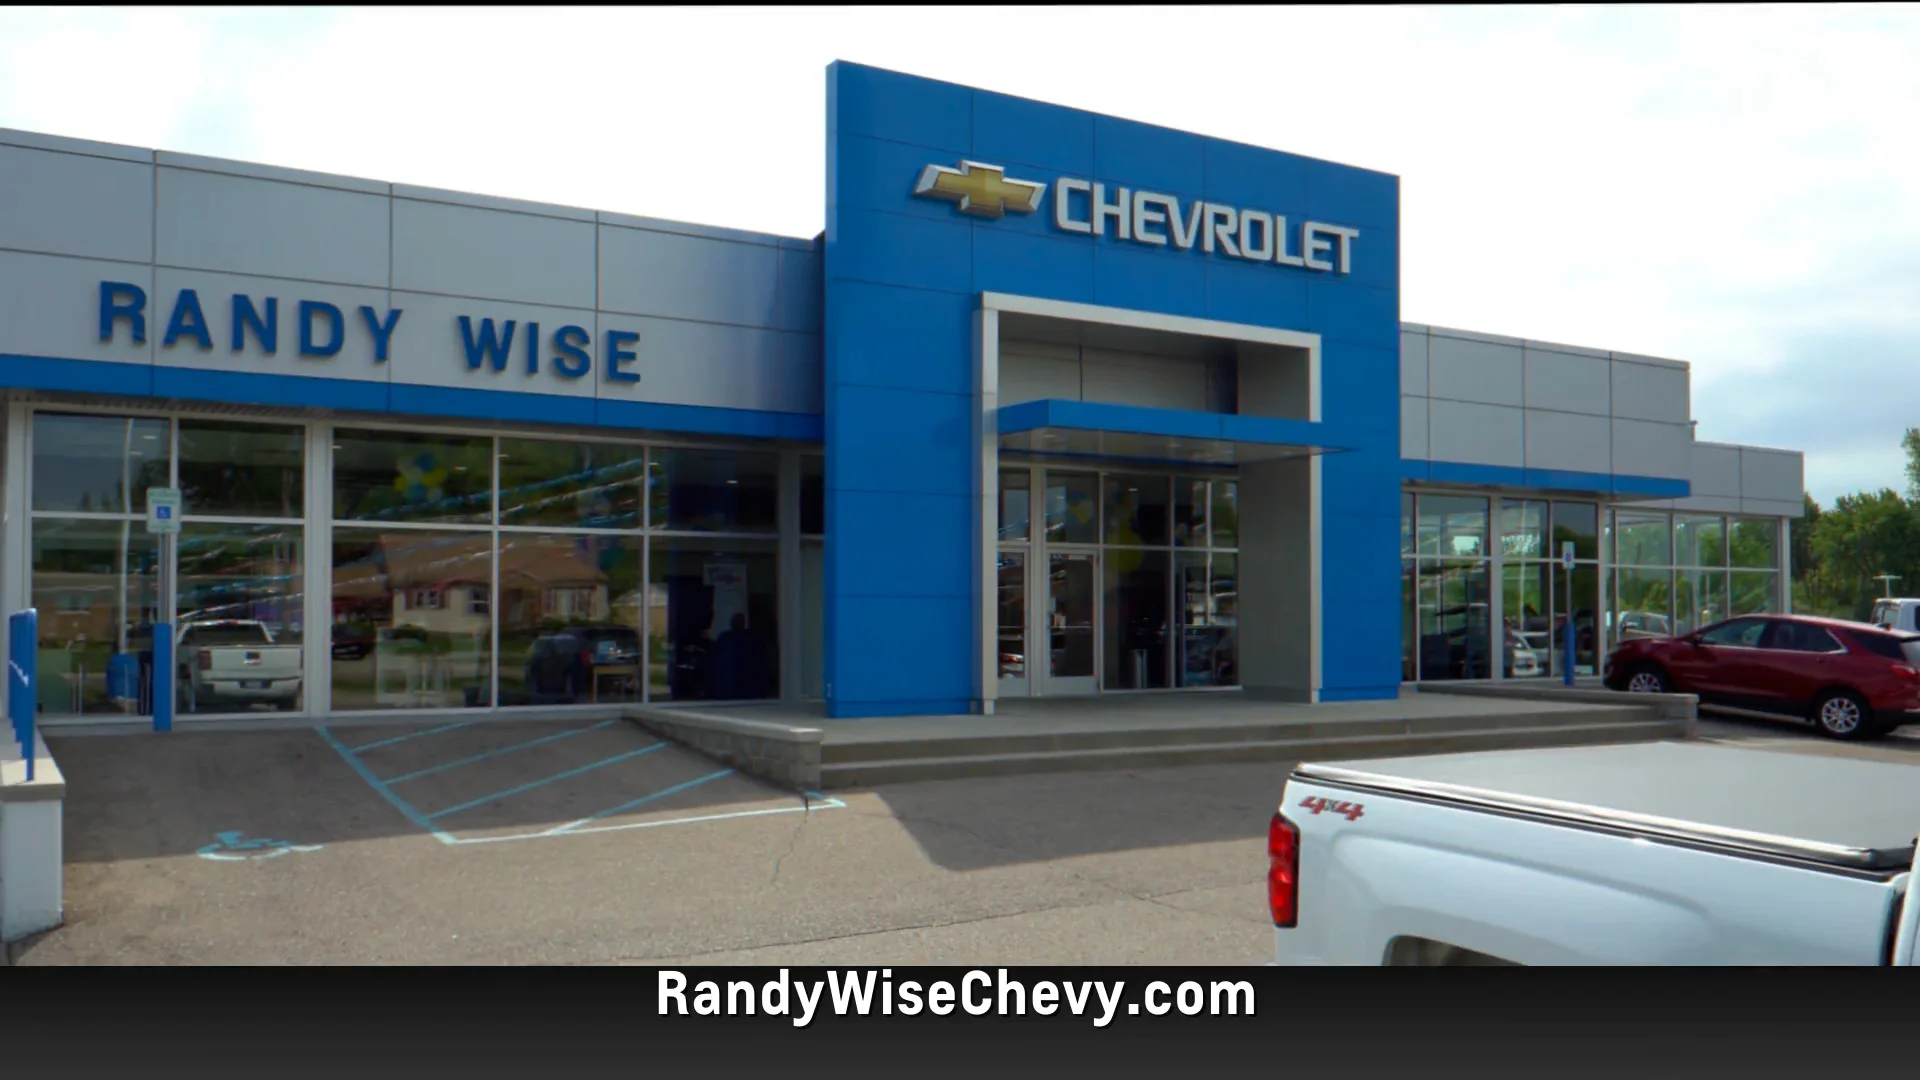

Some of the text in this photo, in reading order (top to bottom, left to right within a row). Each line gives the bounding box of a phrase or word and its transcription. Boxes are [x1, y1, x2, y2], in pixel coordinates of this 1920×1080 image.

[1055, 177, 1359, 274] CHEVROLET
[99, 281, 642, 383] RANDY WISE
